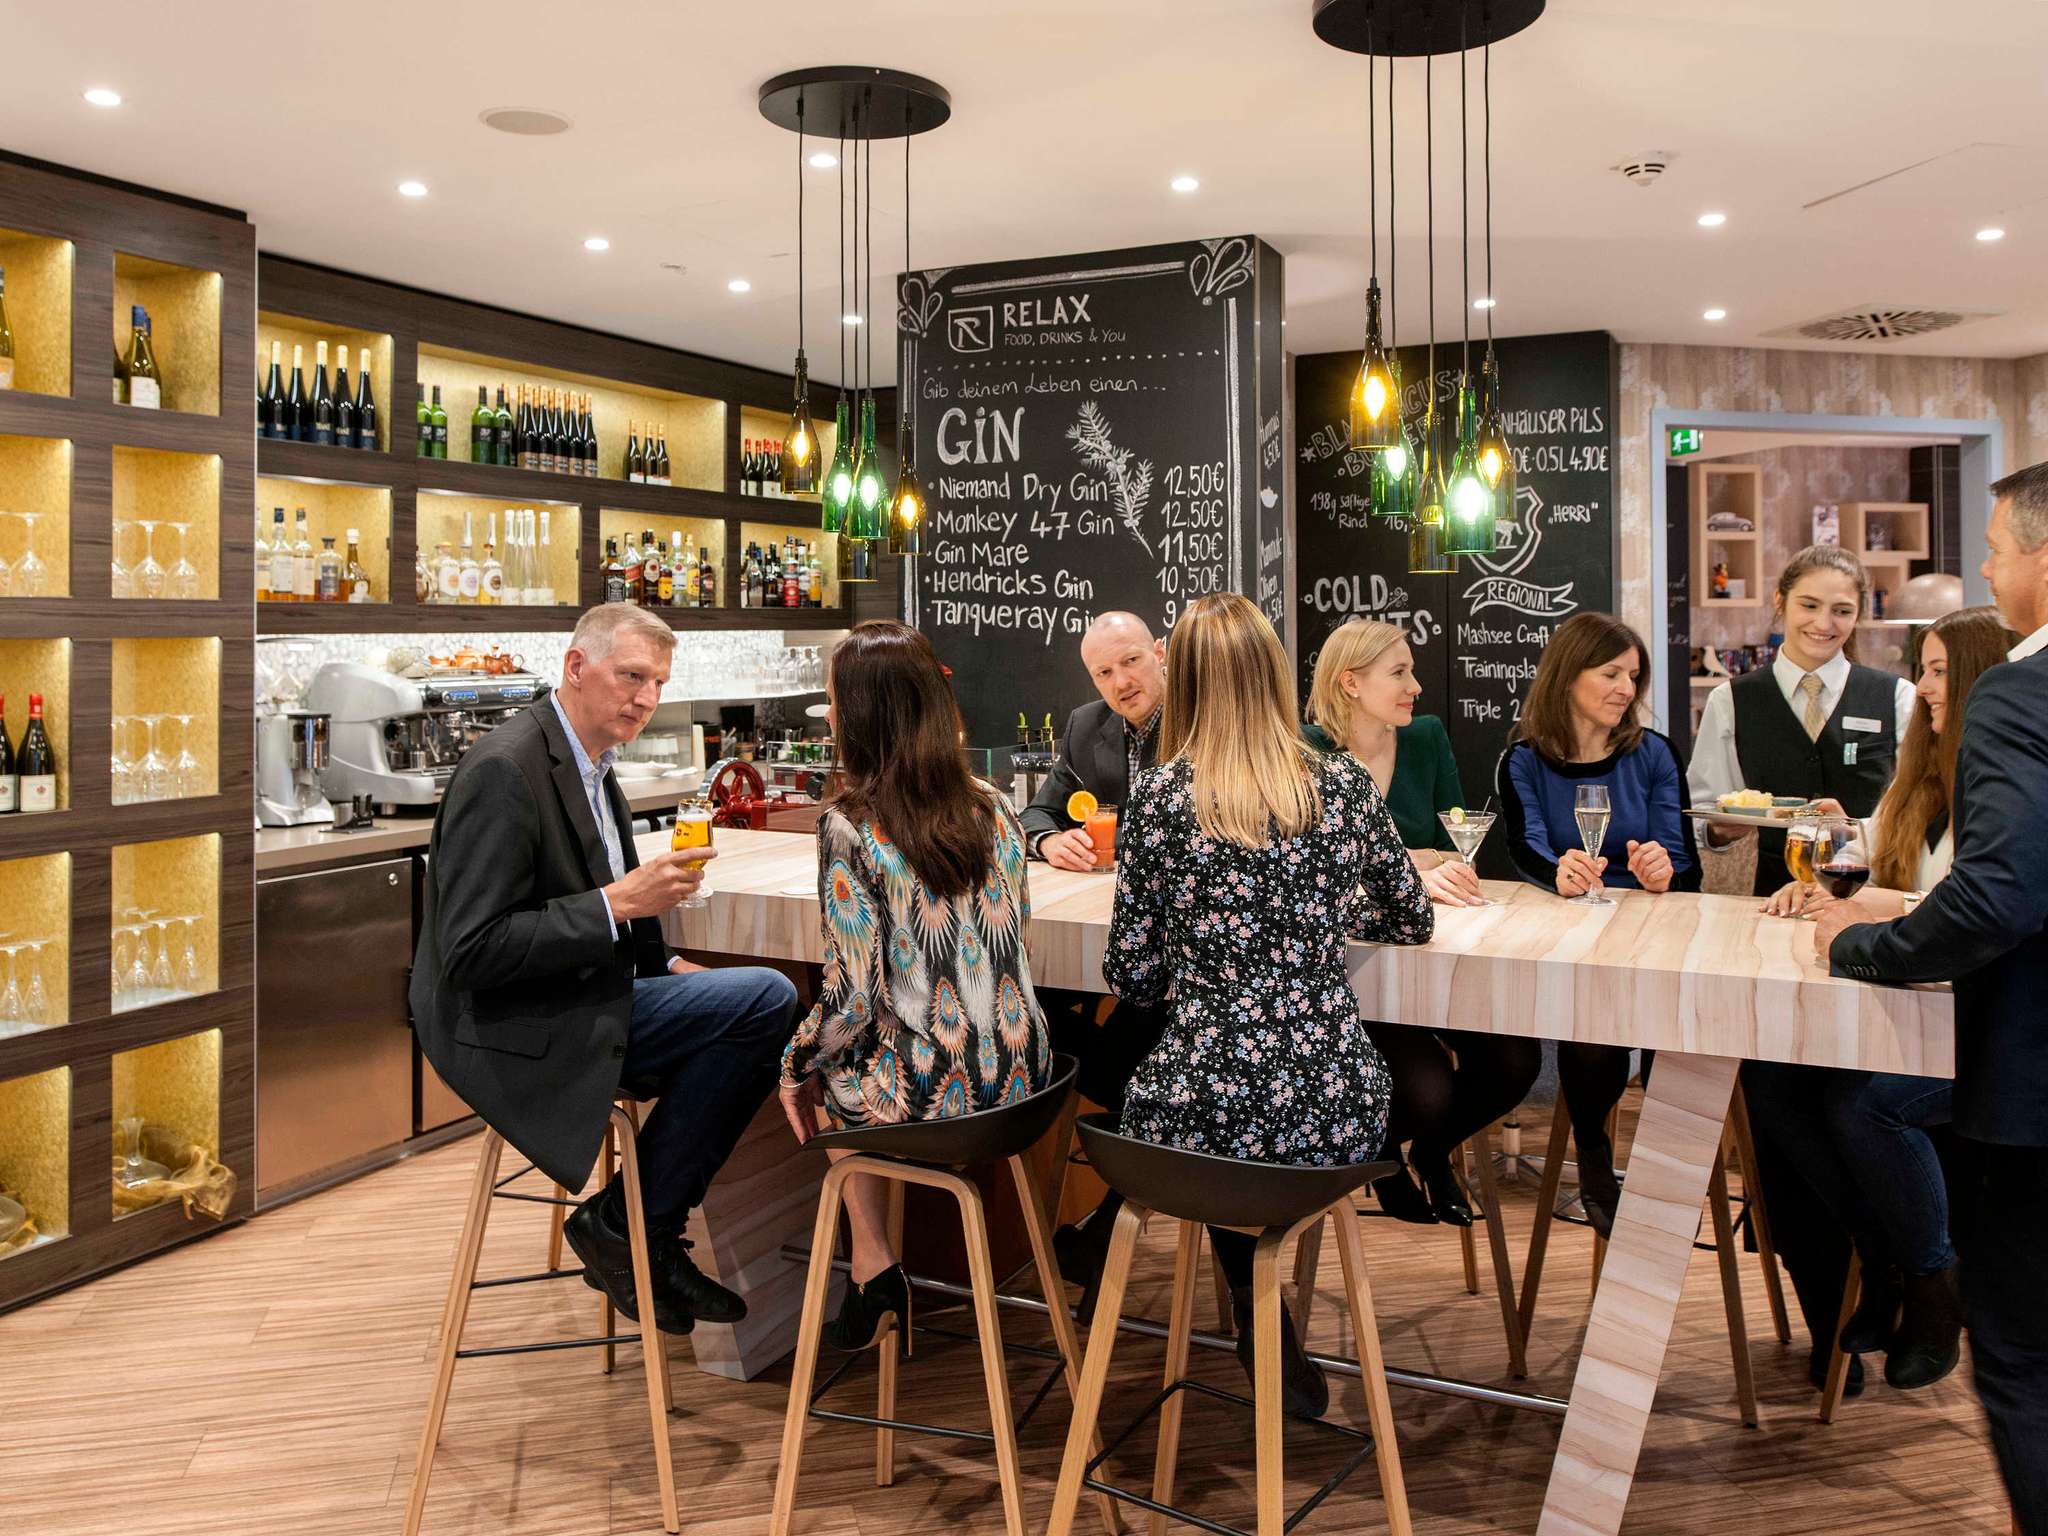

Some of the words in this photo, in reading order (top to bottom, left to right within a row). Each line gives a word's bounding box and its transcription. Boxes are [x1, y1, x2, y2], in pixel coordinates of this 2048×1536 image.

[1003, 293, 1092, 328] RELAX
[1039, 329, 1083, 345] DRINKS
[1088, 326, 1099, 343] &
[922, 376, 950, 400] Gib
[957, 378, 1019, 400] deinem
[1024, 371, 1081, 393] Leben
[939, 475, 1012, 501] Niemand
[1023, 471, 1062, 513] Dry
[1069, 471, 1110, 503] Gin
[1163, 463, 1226, 498] 12,50€
[936, 508, 1018, 544] Monkey
[1029, 510, 1071, 541] 47
[1077, 508, 1115, 536] Gin
[1160, 499, 1225, 530] 12,50€
[1338, 512, 1369, 529] Rind
[934, 539, 966, 565] Gin
[971, 541, 1030, 568] Mare
[1157, 531, 1225, 567] 11,50€
[932, 568, 1046, 597] Hendricks
[1054, 568, 1094, 601] Gin
[1314, 574, 1389, 613] COLD
[1486, 580, 1553, 612] REGIONAL
[931, 598, 1056, 646] Tanqueray
[1063, 606, 1094, 633] Gi
[1457, 621, 1513, 646] Mashsee
[1516, 622, 1550, 649] Craft
[1457, 656, 1538, 694] Trainingsla
[1458, 698, 1502, 723] Triple
